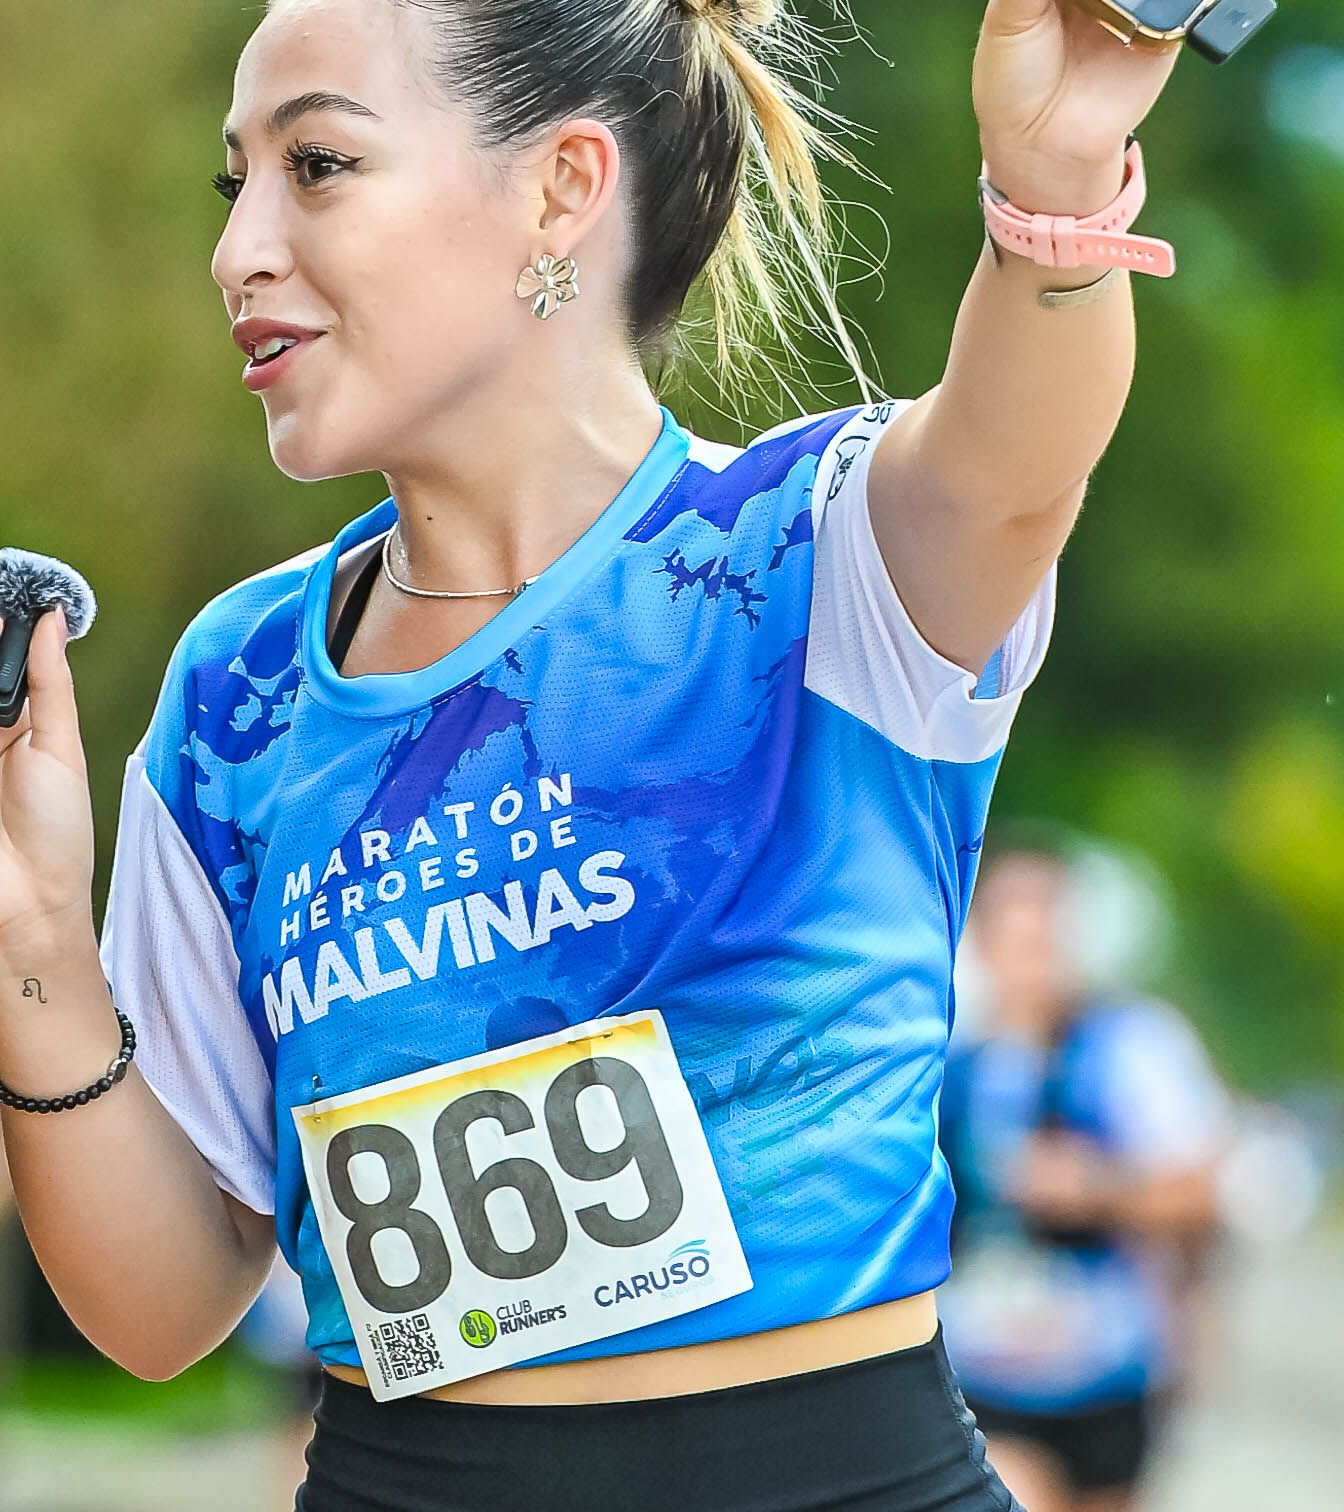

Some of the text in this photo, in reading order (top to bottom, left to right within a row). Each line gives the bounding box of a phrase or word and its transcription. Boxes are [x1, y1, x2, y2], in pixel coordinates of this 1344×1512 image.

[280, 815, 576, 946] HÉROES DE
[281, 773, 572, 906] MARATÓN
[263, 850, 635, 1042] MALVINAS
[327, 1057, 684, 1313] 869
[497, 1300, 532, 1319] CLUB
[500, 1305, 566, 1335] RUNNER'S
[594, 1256, 709, 1307] CARUSO
